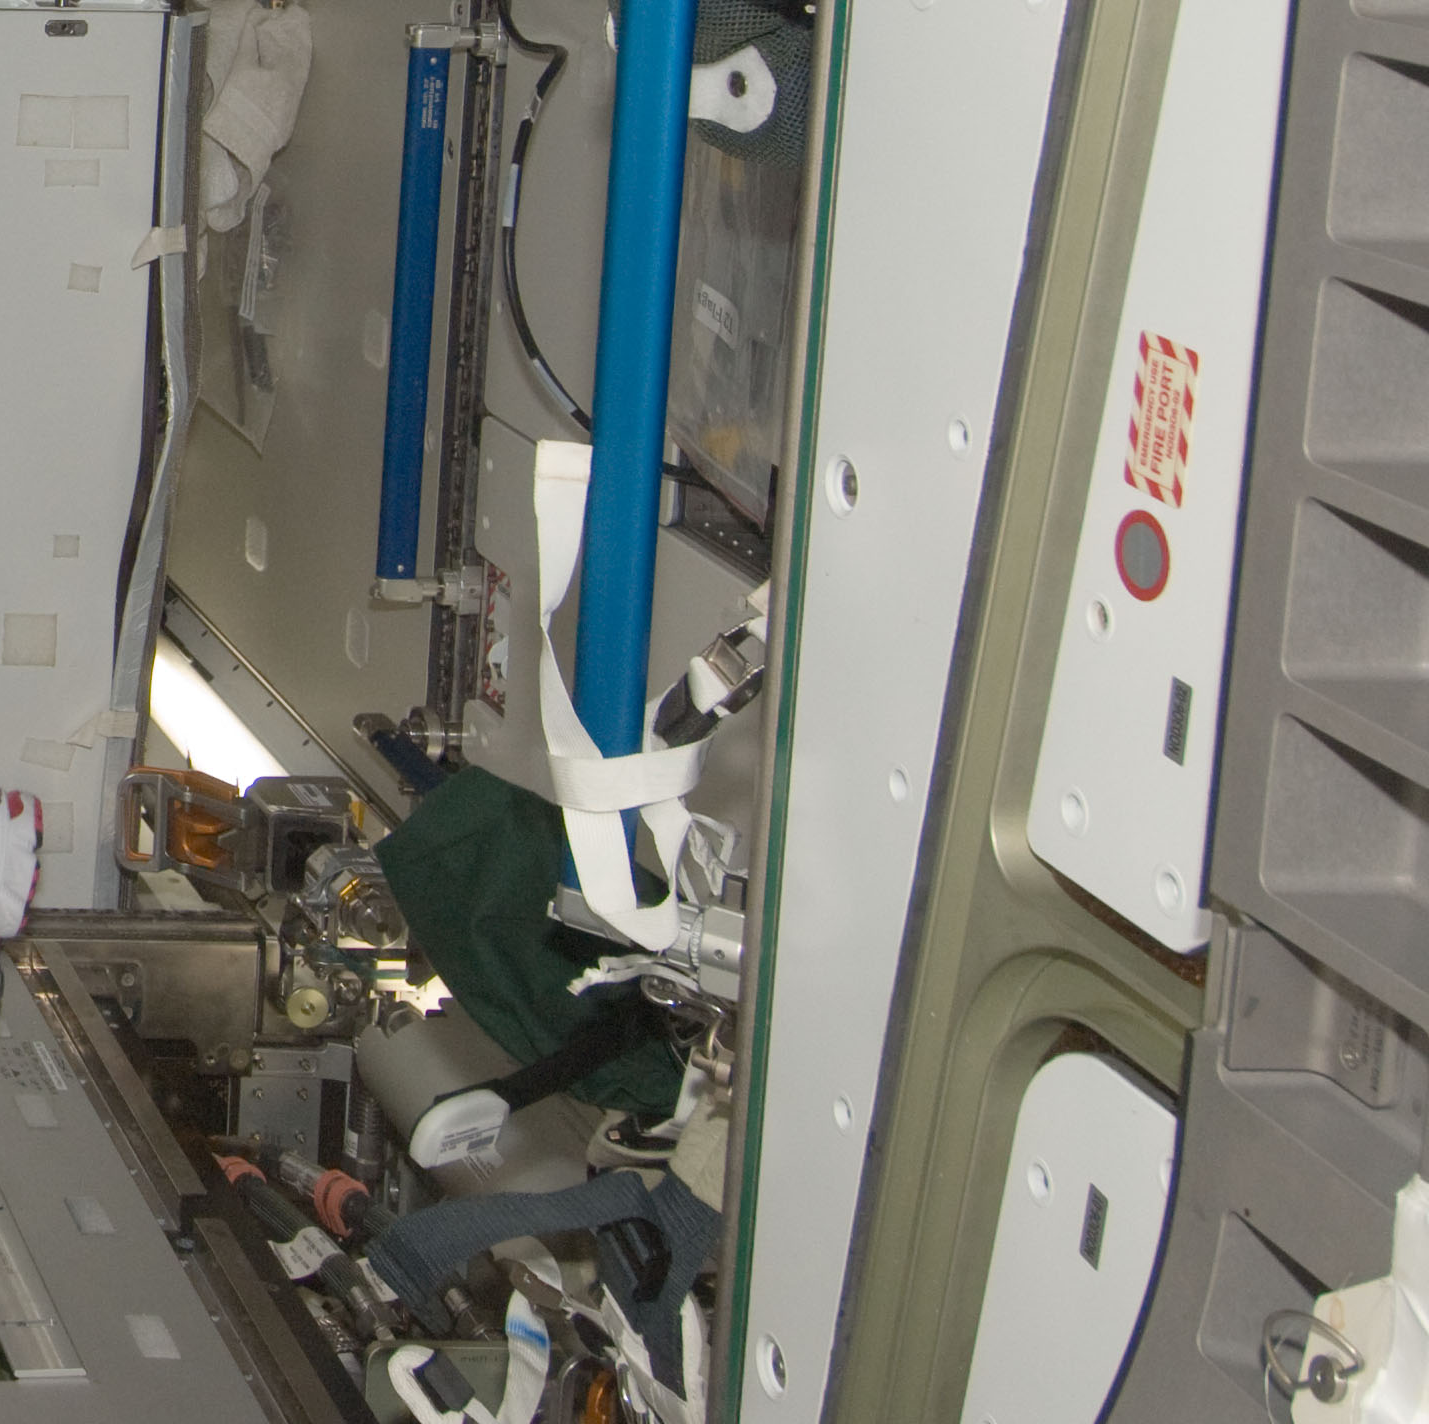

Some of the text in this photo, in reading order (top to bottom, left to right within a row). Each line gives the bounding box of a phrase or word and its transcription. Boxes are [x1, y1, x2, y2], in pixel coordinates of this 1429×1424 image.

[1140, 359, 1159, 466] EMERGENCY USE
[1150, 360, 1174, 476] FIRE PORT
